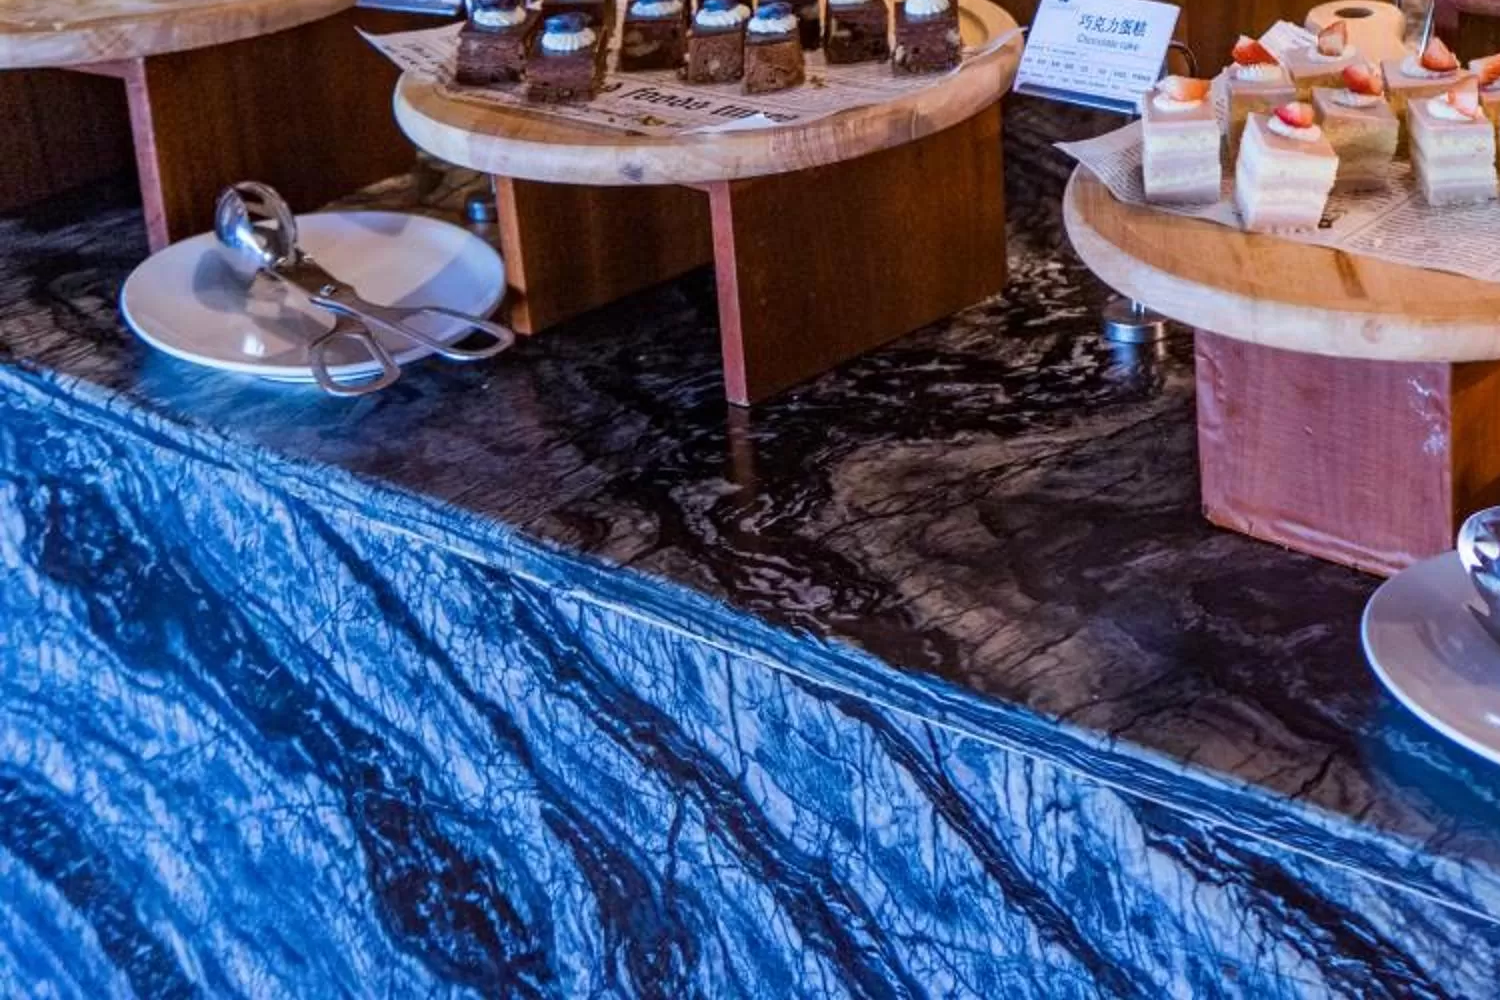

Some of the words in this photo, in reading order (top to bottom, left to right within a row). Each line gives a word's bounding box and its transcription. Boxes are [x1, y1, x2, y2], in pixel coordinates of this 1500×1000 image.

[1078, 13, 1147, 37] 巧克力蛋糕
